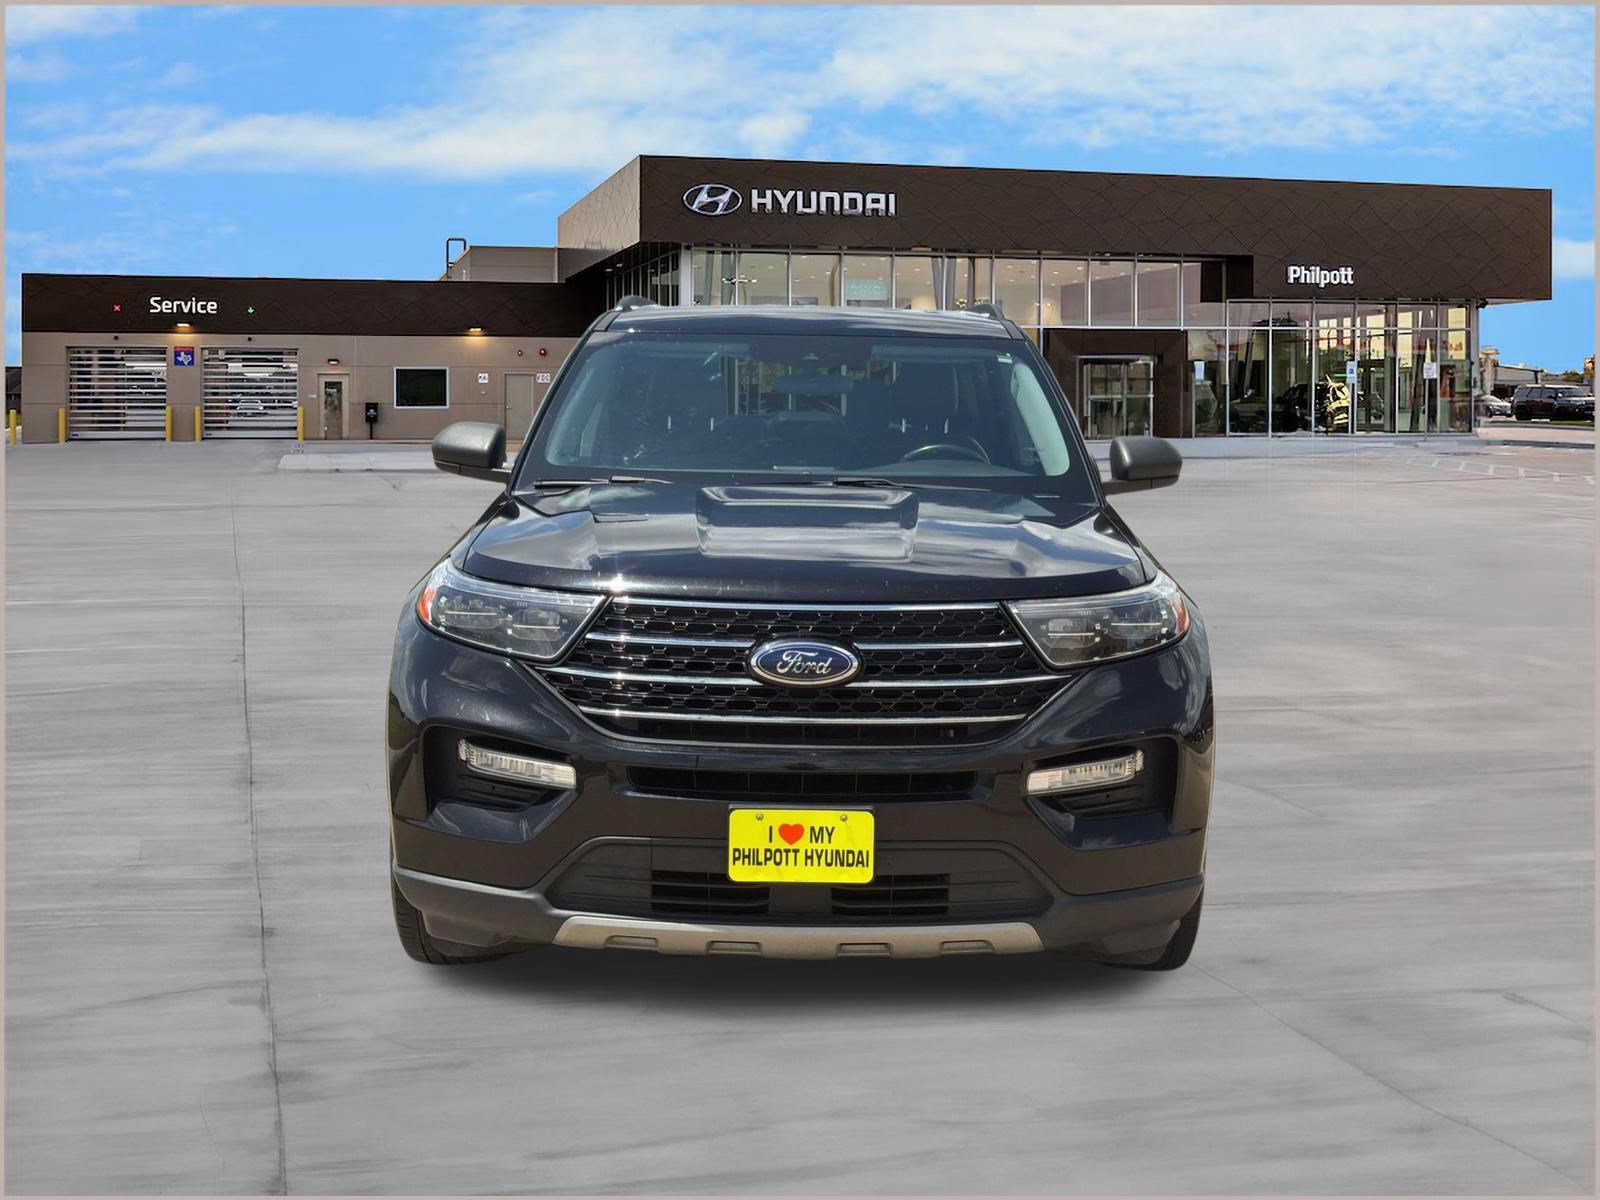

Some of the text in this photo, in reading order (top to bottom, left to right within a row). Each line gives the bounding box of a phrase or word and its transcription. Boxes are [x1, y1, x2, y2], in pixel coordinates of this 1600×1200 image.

[750, 188, 897, 217] HYUNDAI
[1287, 265, 1355, 288] Philpott
[149, 296, 218, 314] Service
[776, 650, 832, 675] Ford
[809, 825, 836, 844] MY
[732, 847, 870, 868] PHILPOTT HYUNDAI
